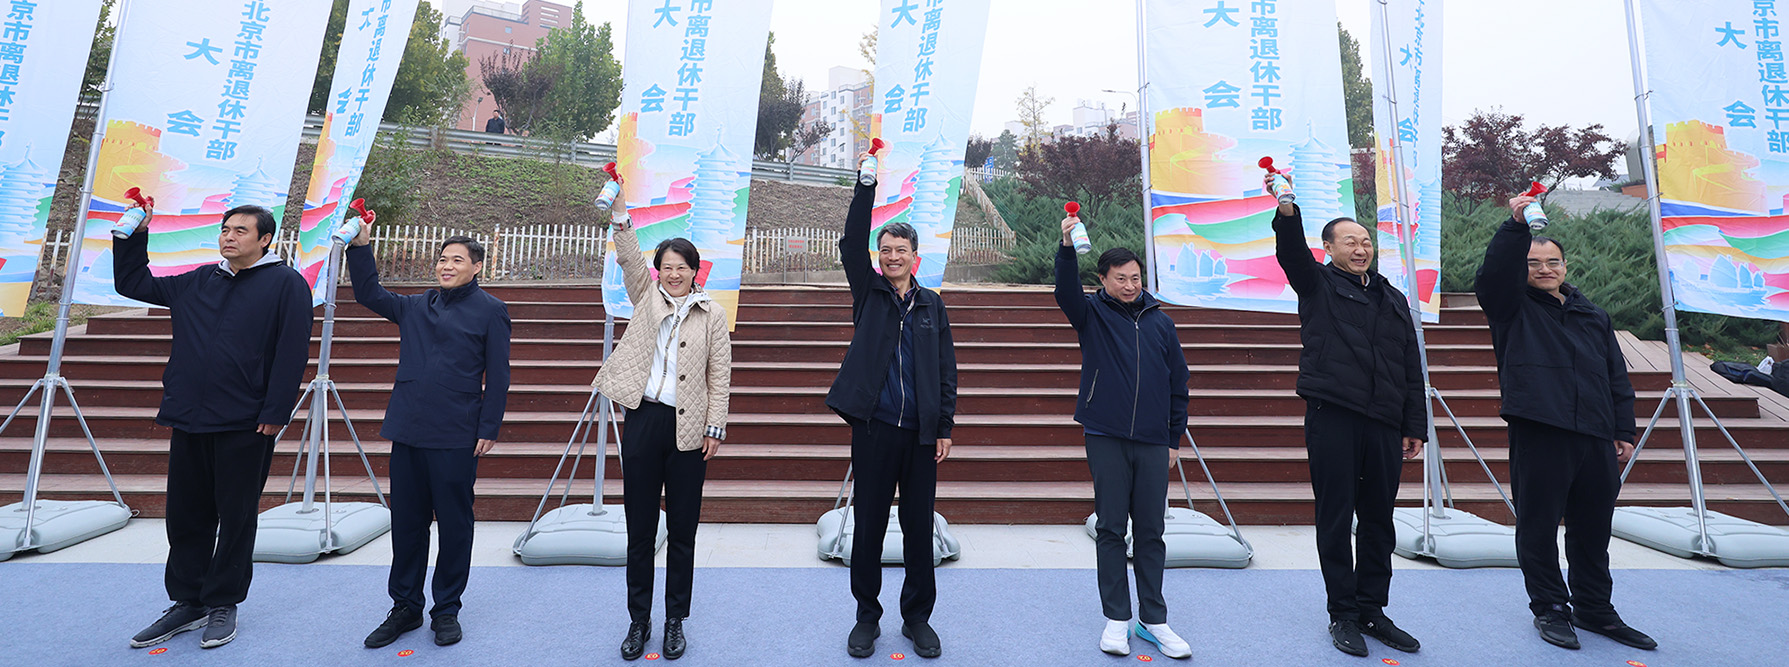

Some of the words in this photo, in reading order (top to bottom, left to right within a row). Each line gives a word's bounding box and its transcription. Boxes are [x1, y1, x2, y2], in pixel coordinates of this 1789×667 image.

[205, 0, 271, 161] 北京市离退休干部
